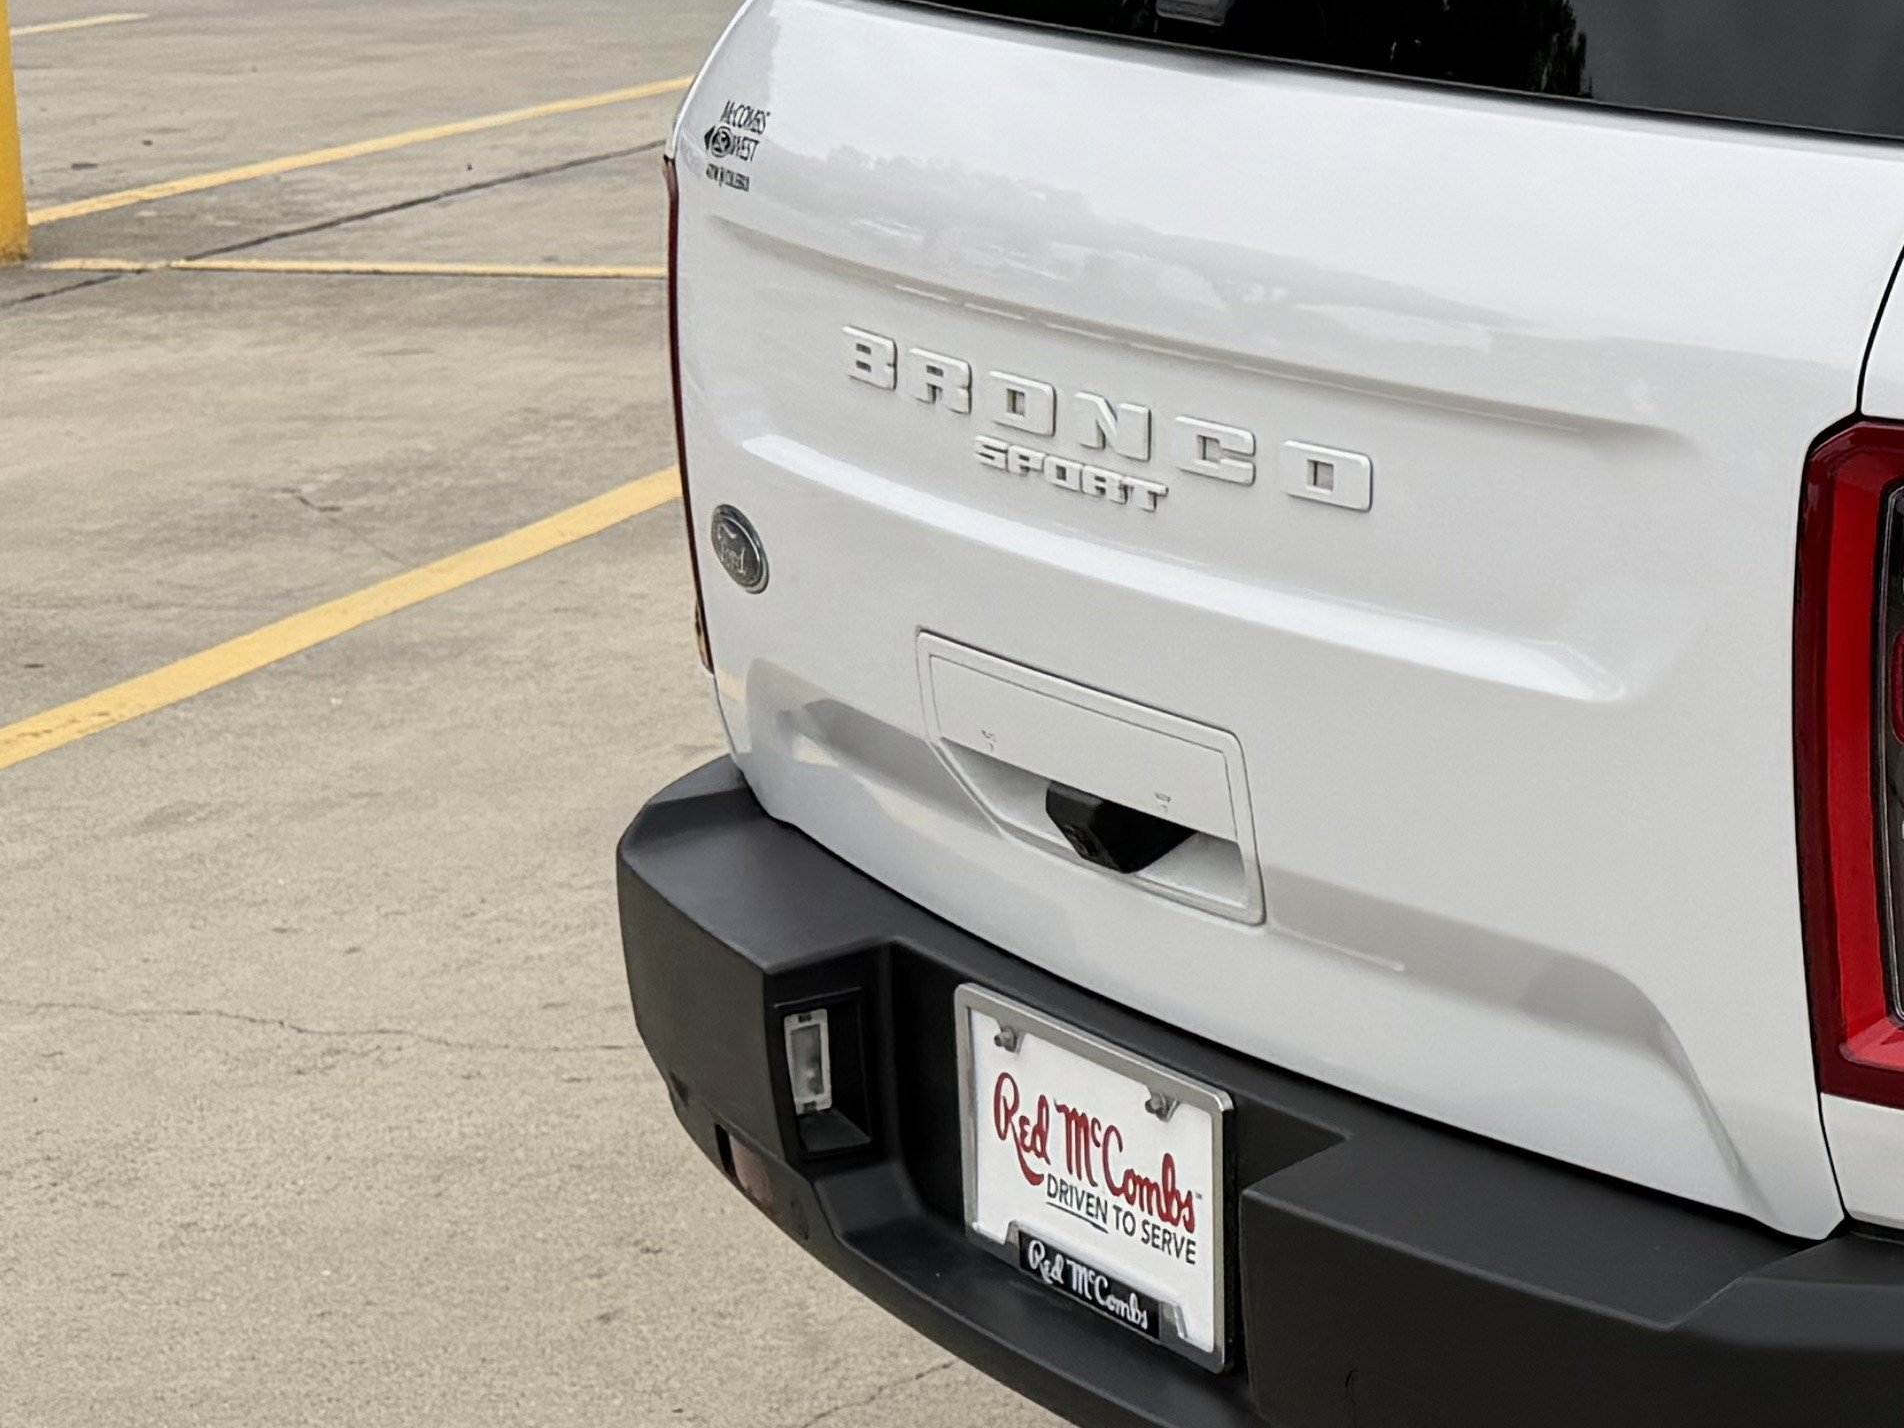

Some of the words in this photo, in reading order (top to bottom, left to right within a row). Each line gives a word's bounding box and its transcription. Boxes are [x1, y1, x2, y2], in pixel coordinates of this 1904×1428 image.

[842, 325, 1374, 512] BRONCO
[974, 434, 1170, 512] SPORT
[994, 1072, 1051, 1186] Red
[1028, 1239, 1064, 1284] Red
[1047, 1173, 1108, 1224] DRIVEN
[1113, 1204, 1137, 1237] TO
[1141, 1221, 1196, 1265] SERVE
